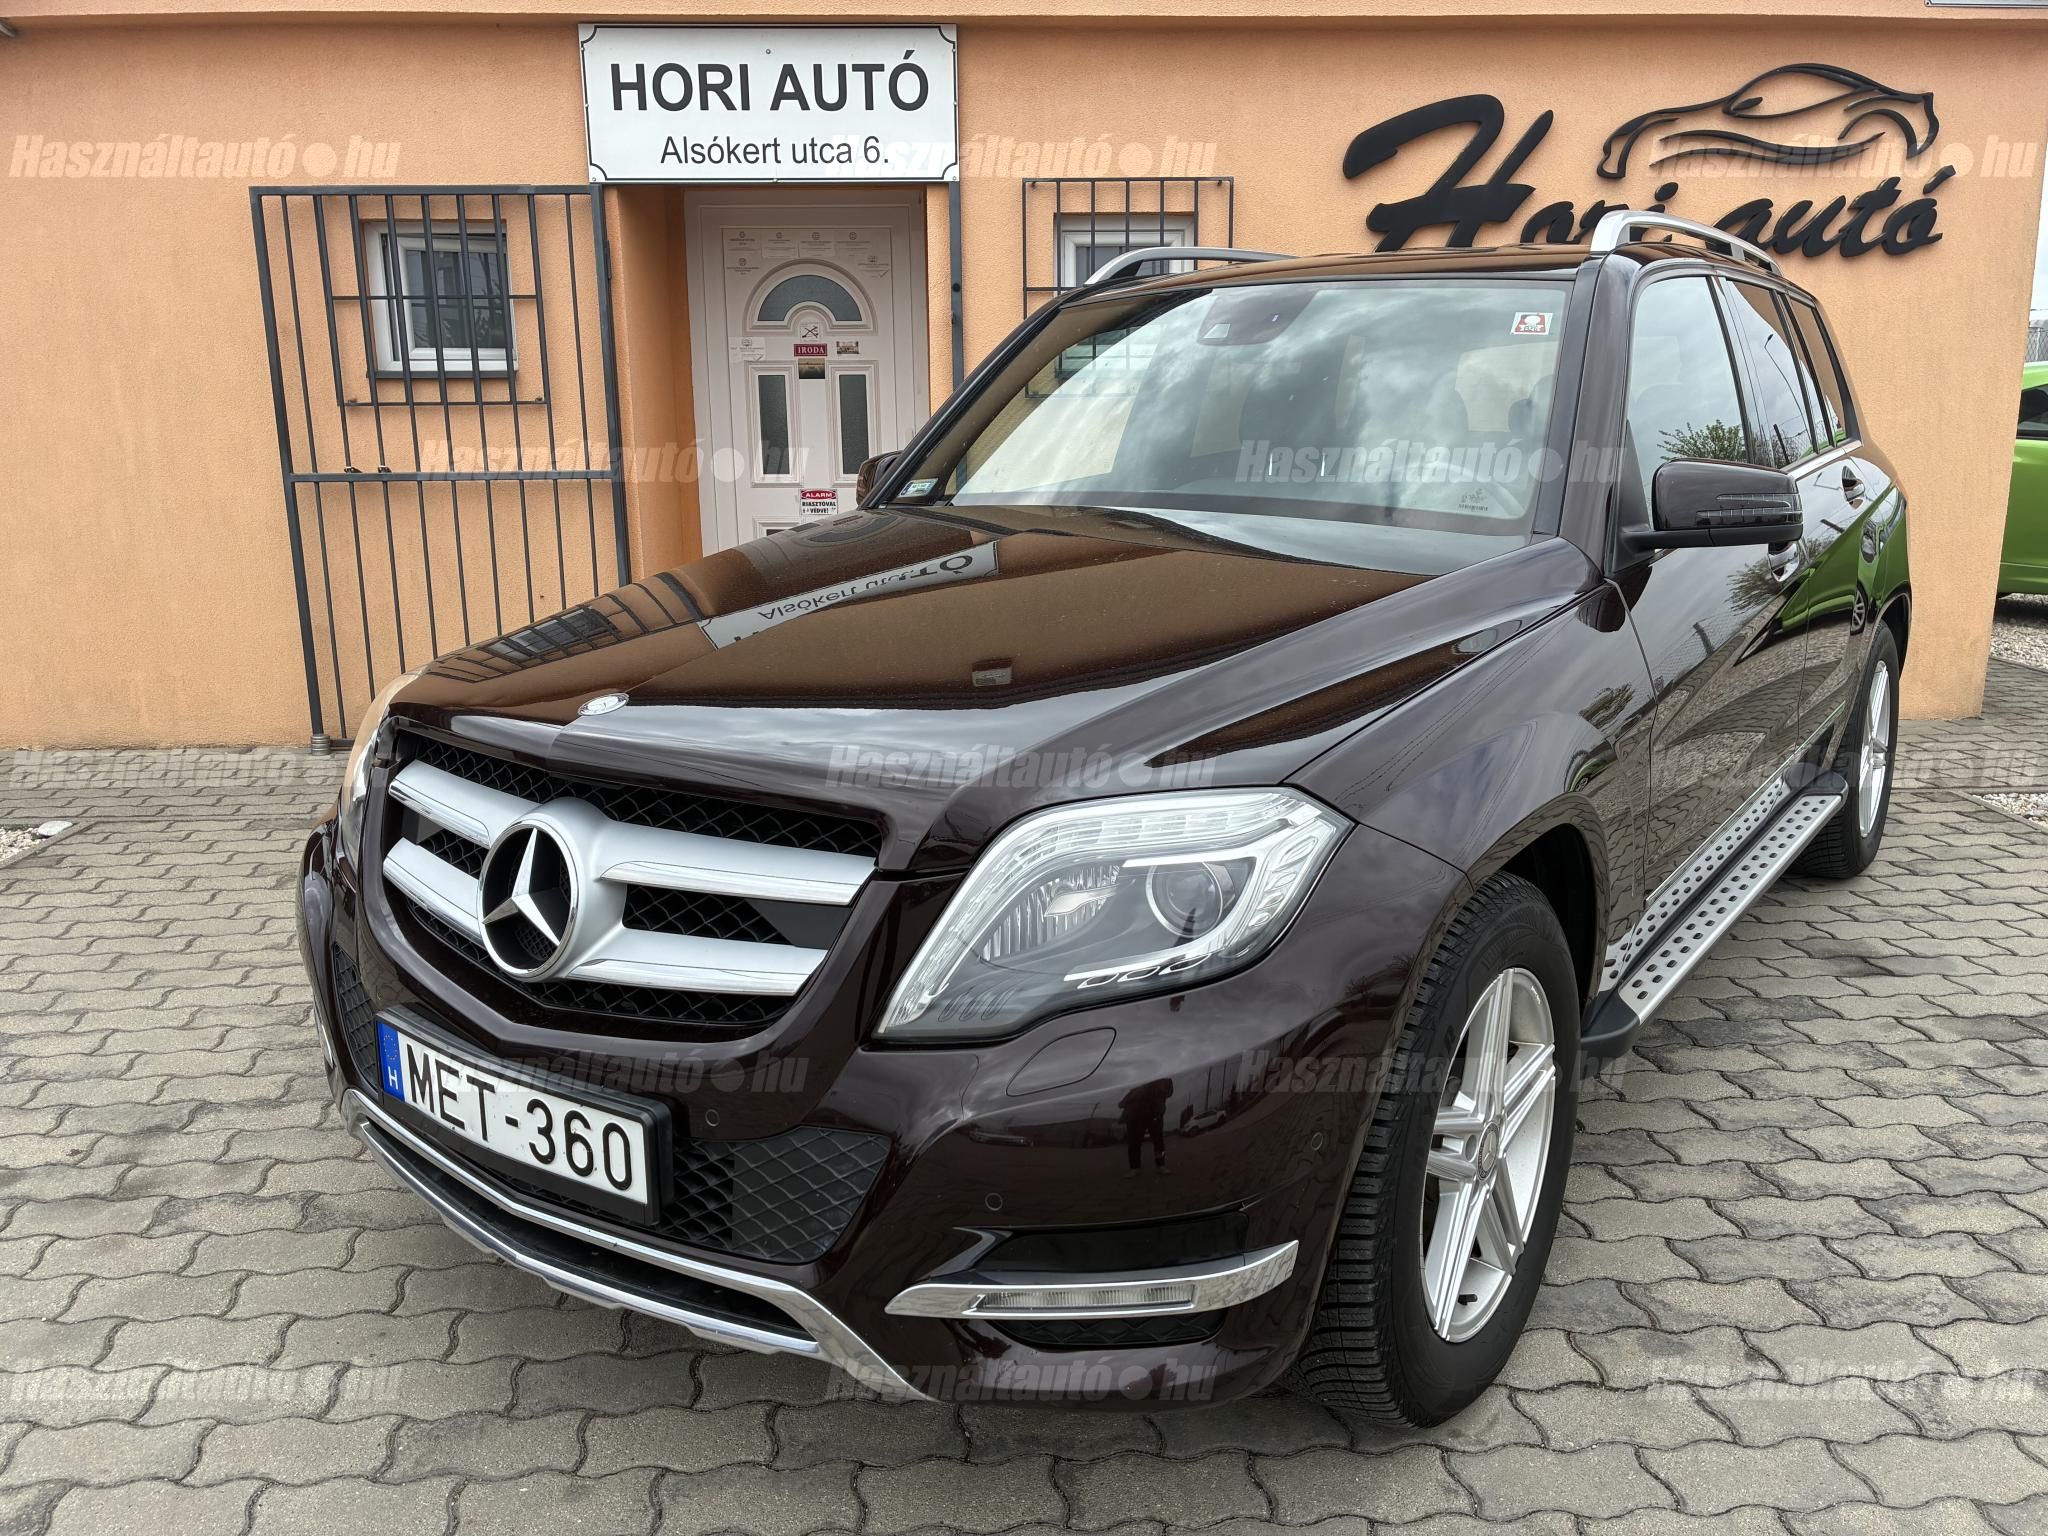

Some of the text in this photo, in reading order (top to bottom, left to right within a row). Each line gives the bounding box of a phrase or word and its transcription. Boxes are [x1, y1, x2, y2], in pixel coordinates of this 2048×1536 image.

[610, 50, 929, 112] HORI AUTÓ
[660, 135, 890, 164] Alsókert utca 6.
[387, 1066, 400, 1091] H
[406, 1042, 633, 1192] MET-360
